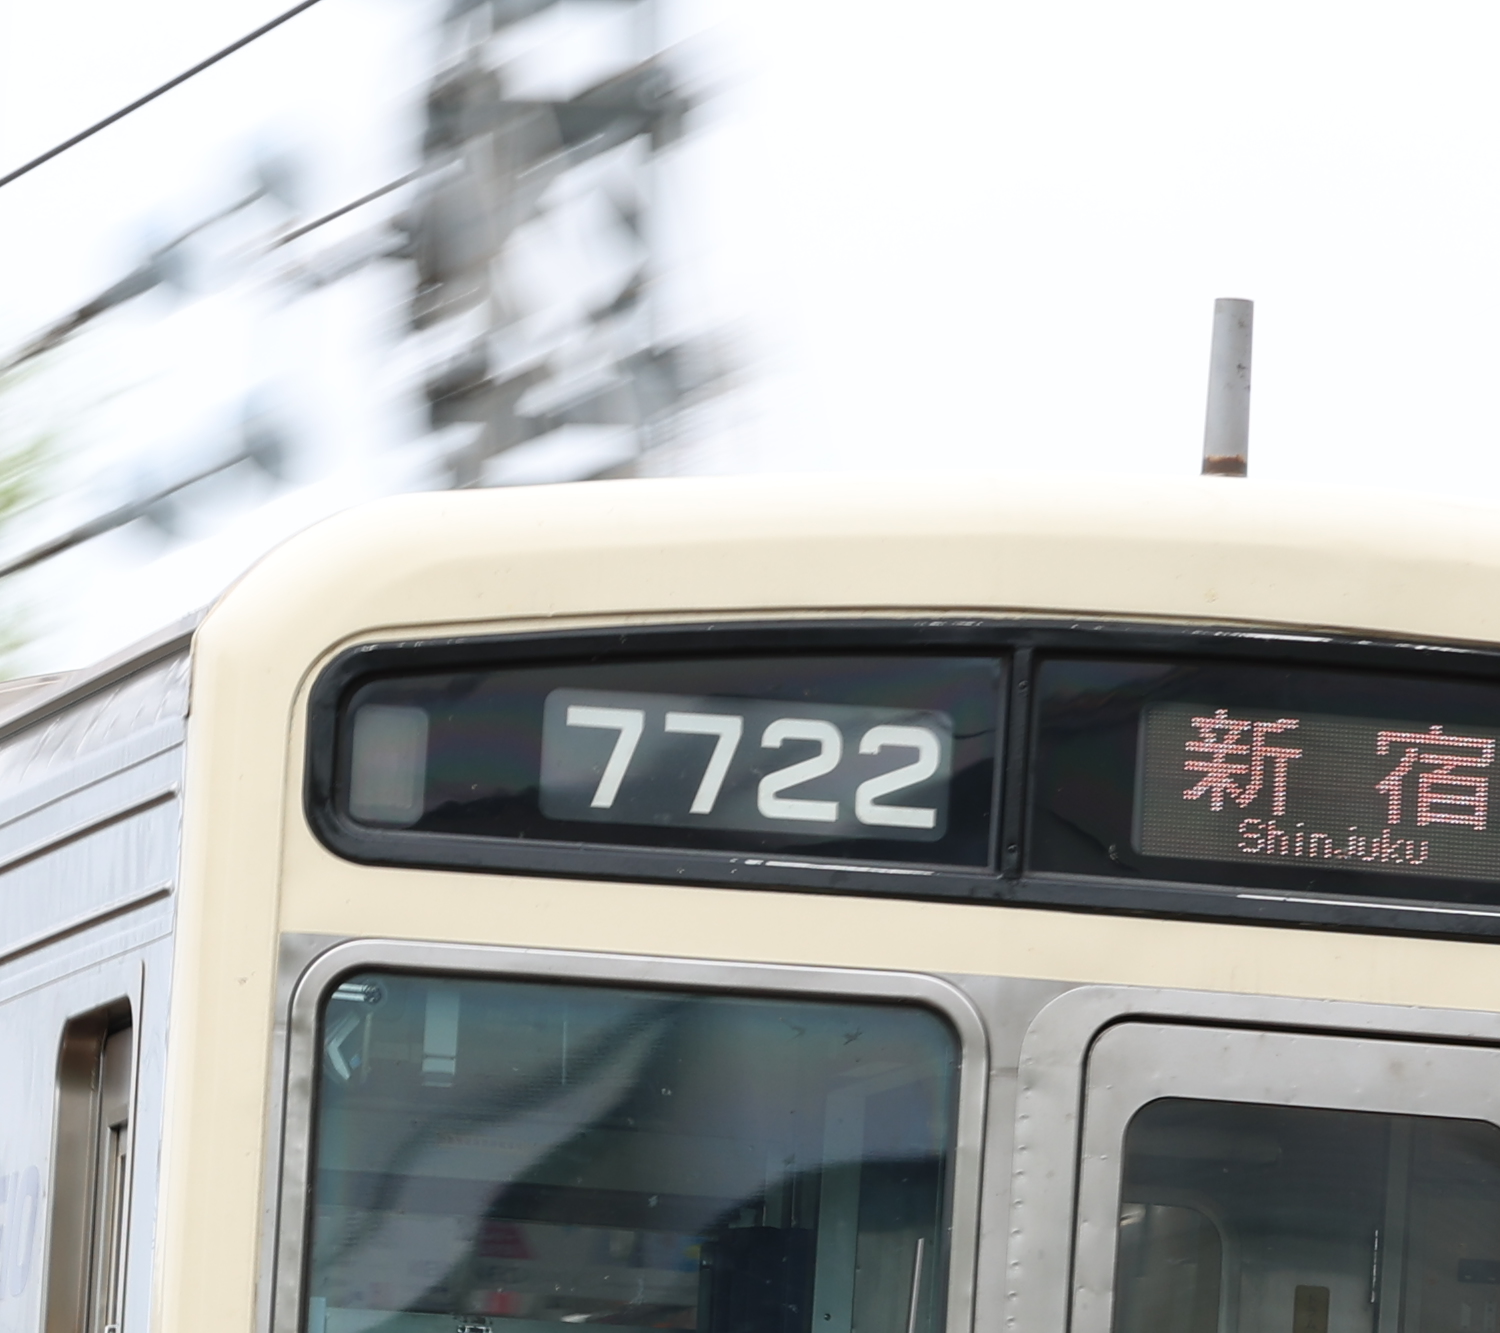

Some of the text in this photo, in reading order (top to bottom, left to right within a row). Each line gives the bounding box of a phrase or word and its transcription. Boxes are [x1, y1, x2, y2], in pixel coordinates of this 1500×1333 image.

[565, 704, 941, 829] 7722
[1182, 708, 1496, 831] 新宿
[1238, 818, 1429, 864] Shinjuku
